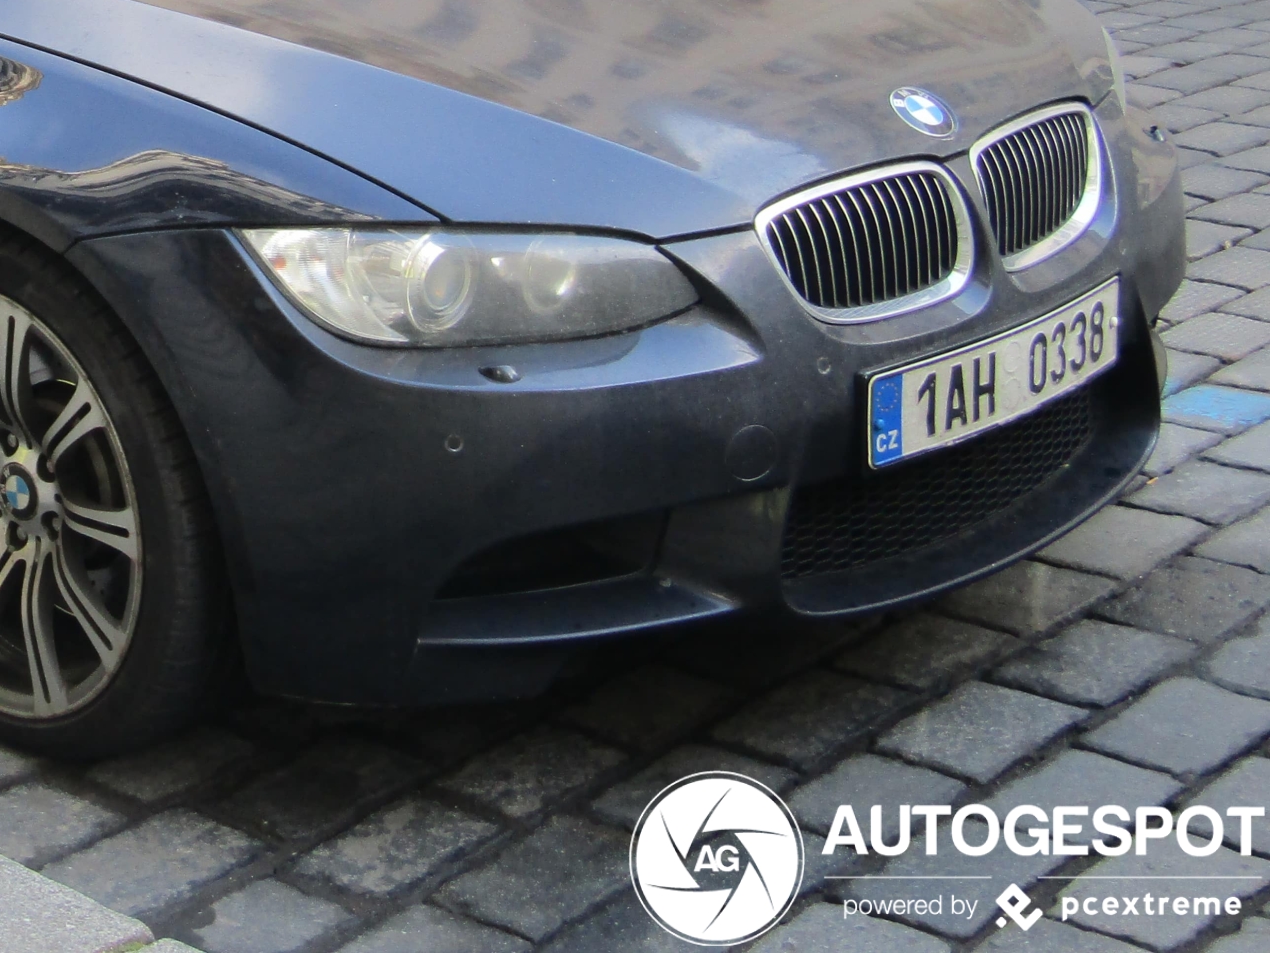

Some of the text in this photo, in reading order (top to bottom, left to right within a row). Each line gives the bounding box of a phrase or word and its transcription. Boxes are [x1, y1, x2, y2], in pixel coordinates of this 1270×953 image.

[917, 300, 1105, 438] 1AH 0338
[876, 430, 898, 453] CZ
